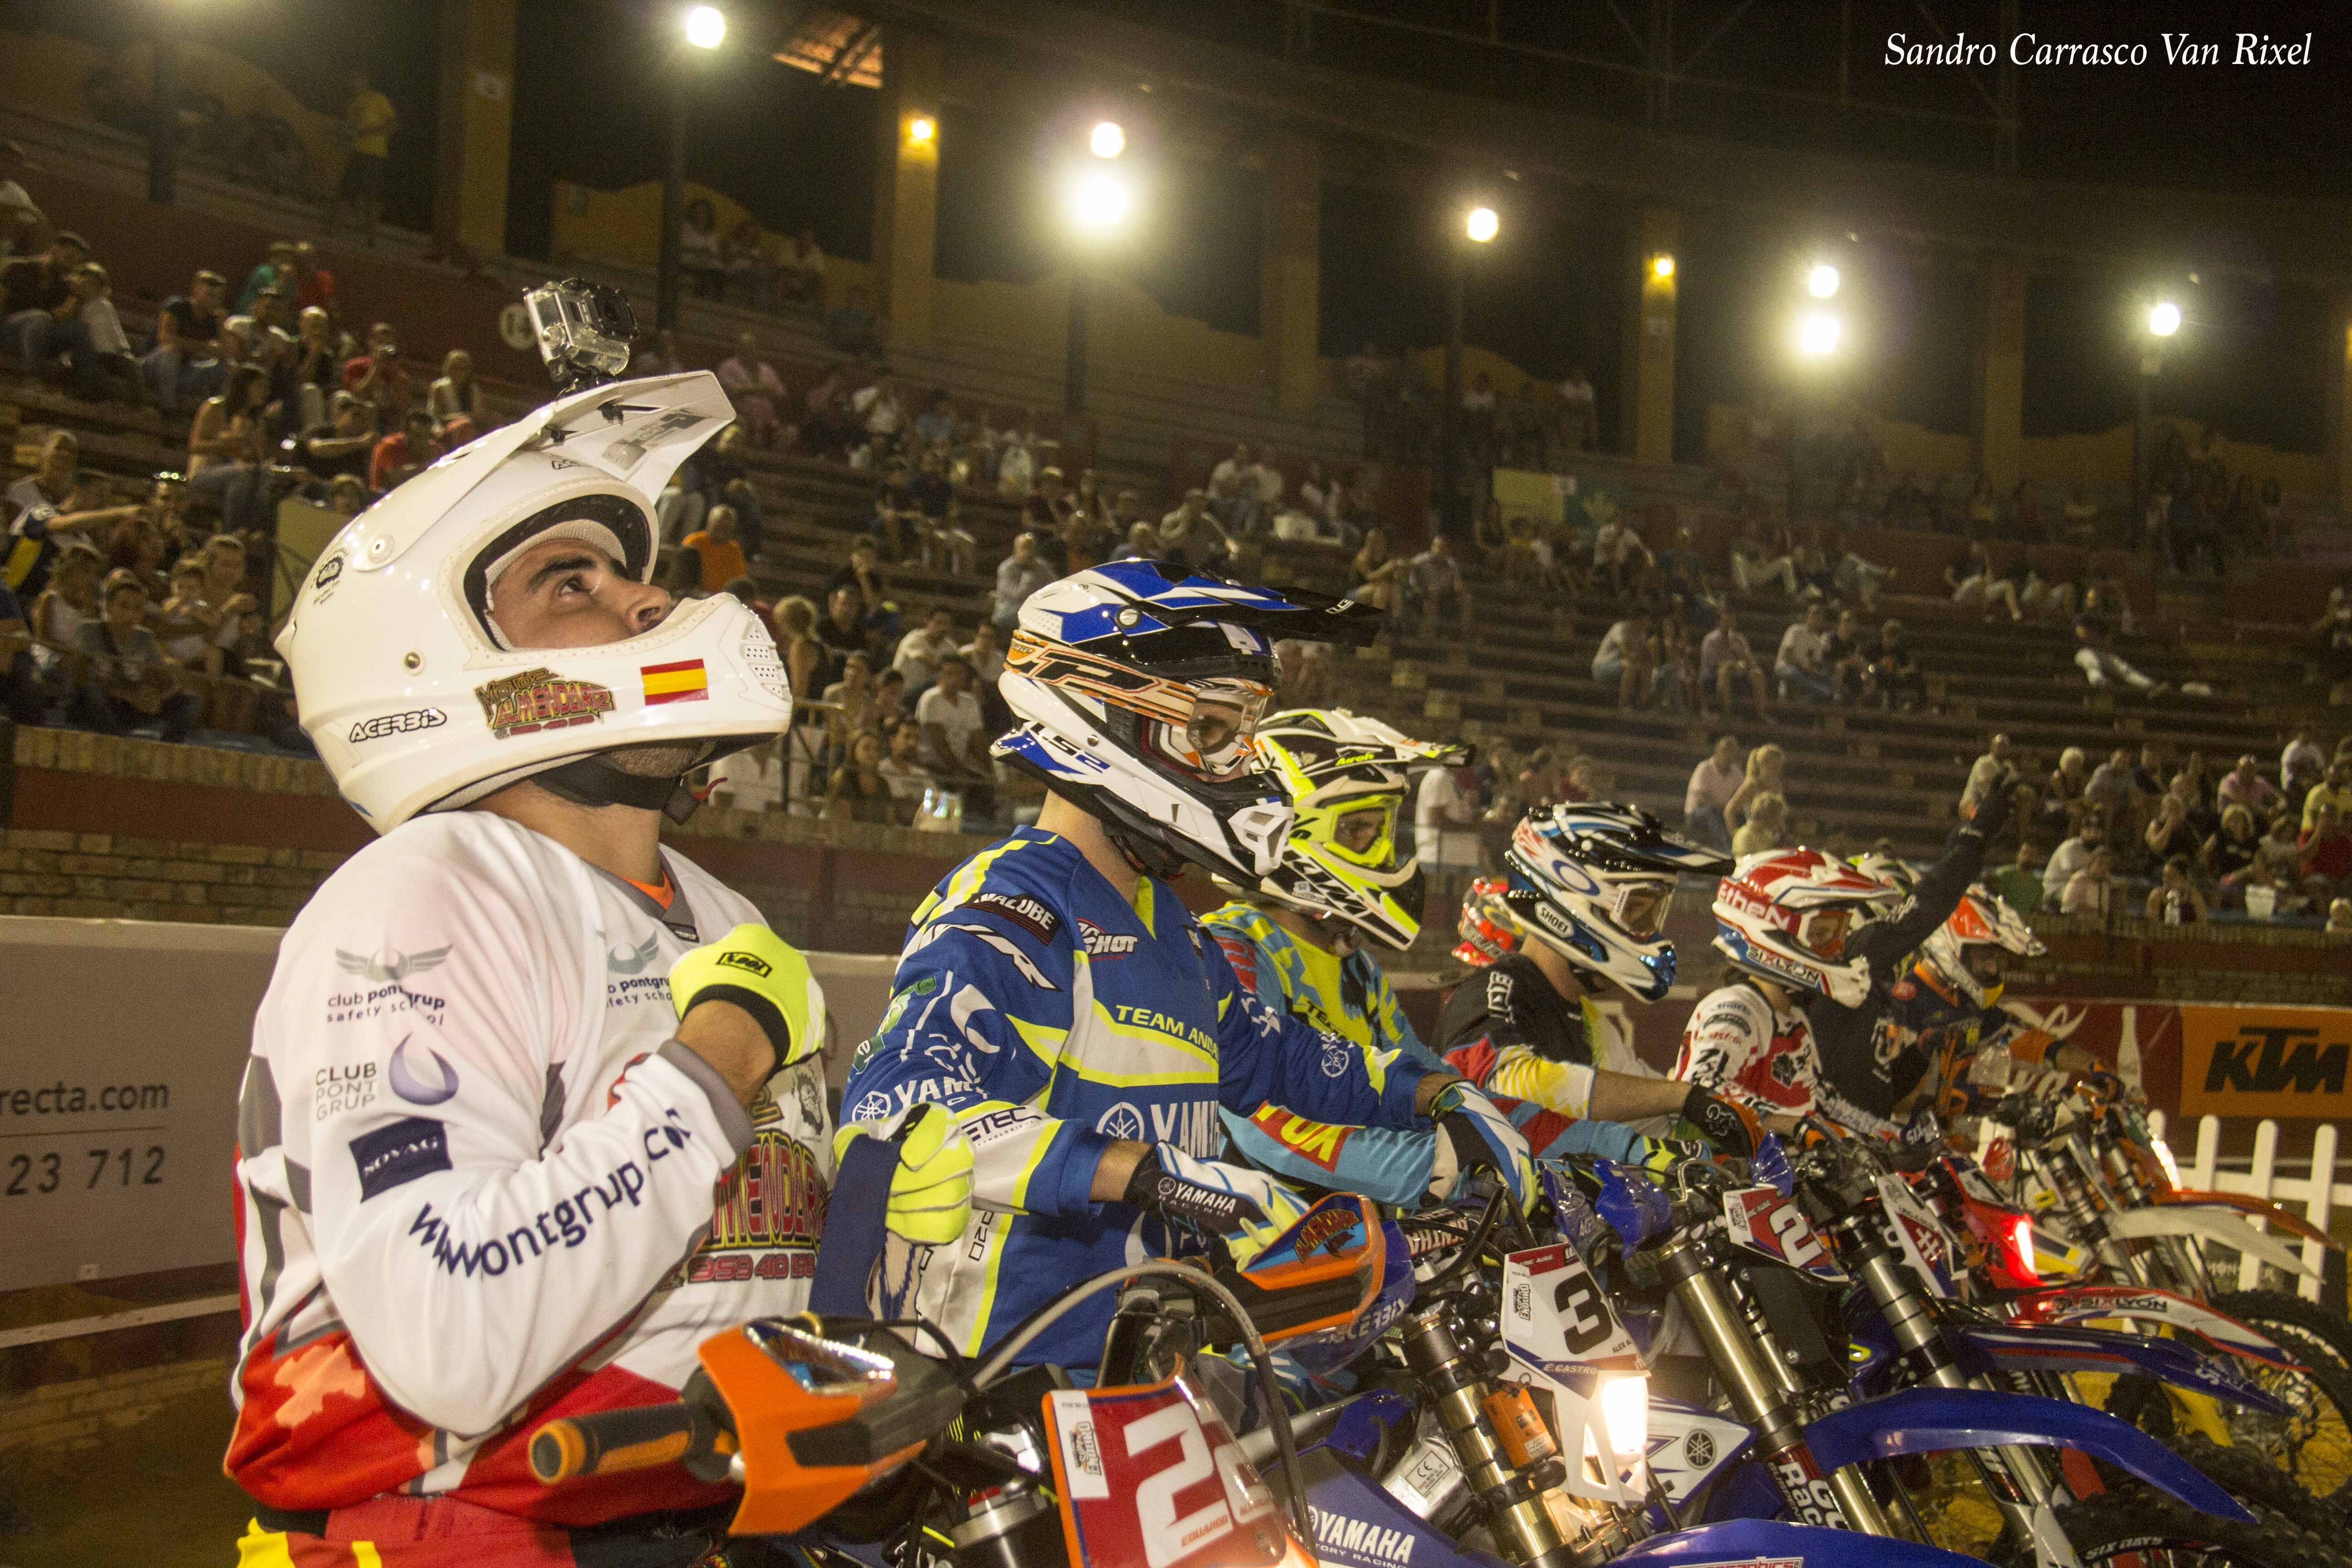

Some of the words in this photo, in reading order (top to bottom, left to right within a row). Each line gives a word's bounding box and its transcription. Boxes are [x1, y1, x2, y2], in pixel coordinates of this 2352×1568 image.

[348, 707, 447, 743] ACERBIS
[1539, 906, 1569, 933] SHOEI
[328, 992, 363, 1007] club
[1116, 1004, 1184, 1037] TEAM
[316, 1062, 377, 1085] CLUB
[2204, 1027, 2351, 1094] KTM
[317, 1079, 377, 1105] PONT
[317, 1093, 376, 1122] GRUP
[6, 1153, 61, 1196] 23
[1173, 1183, 1237, 1214] YAMAHA
[1769, 1203, 1822, 1269] 2
[1554, 1270, 1613, 1355] 3
[1318, 1509, 1415, 1564] YAMAHA
